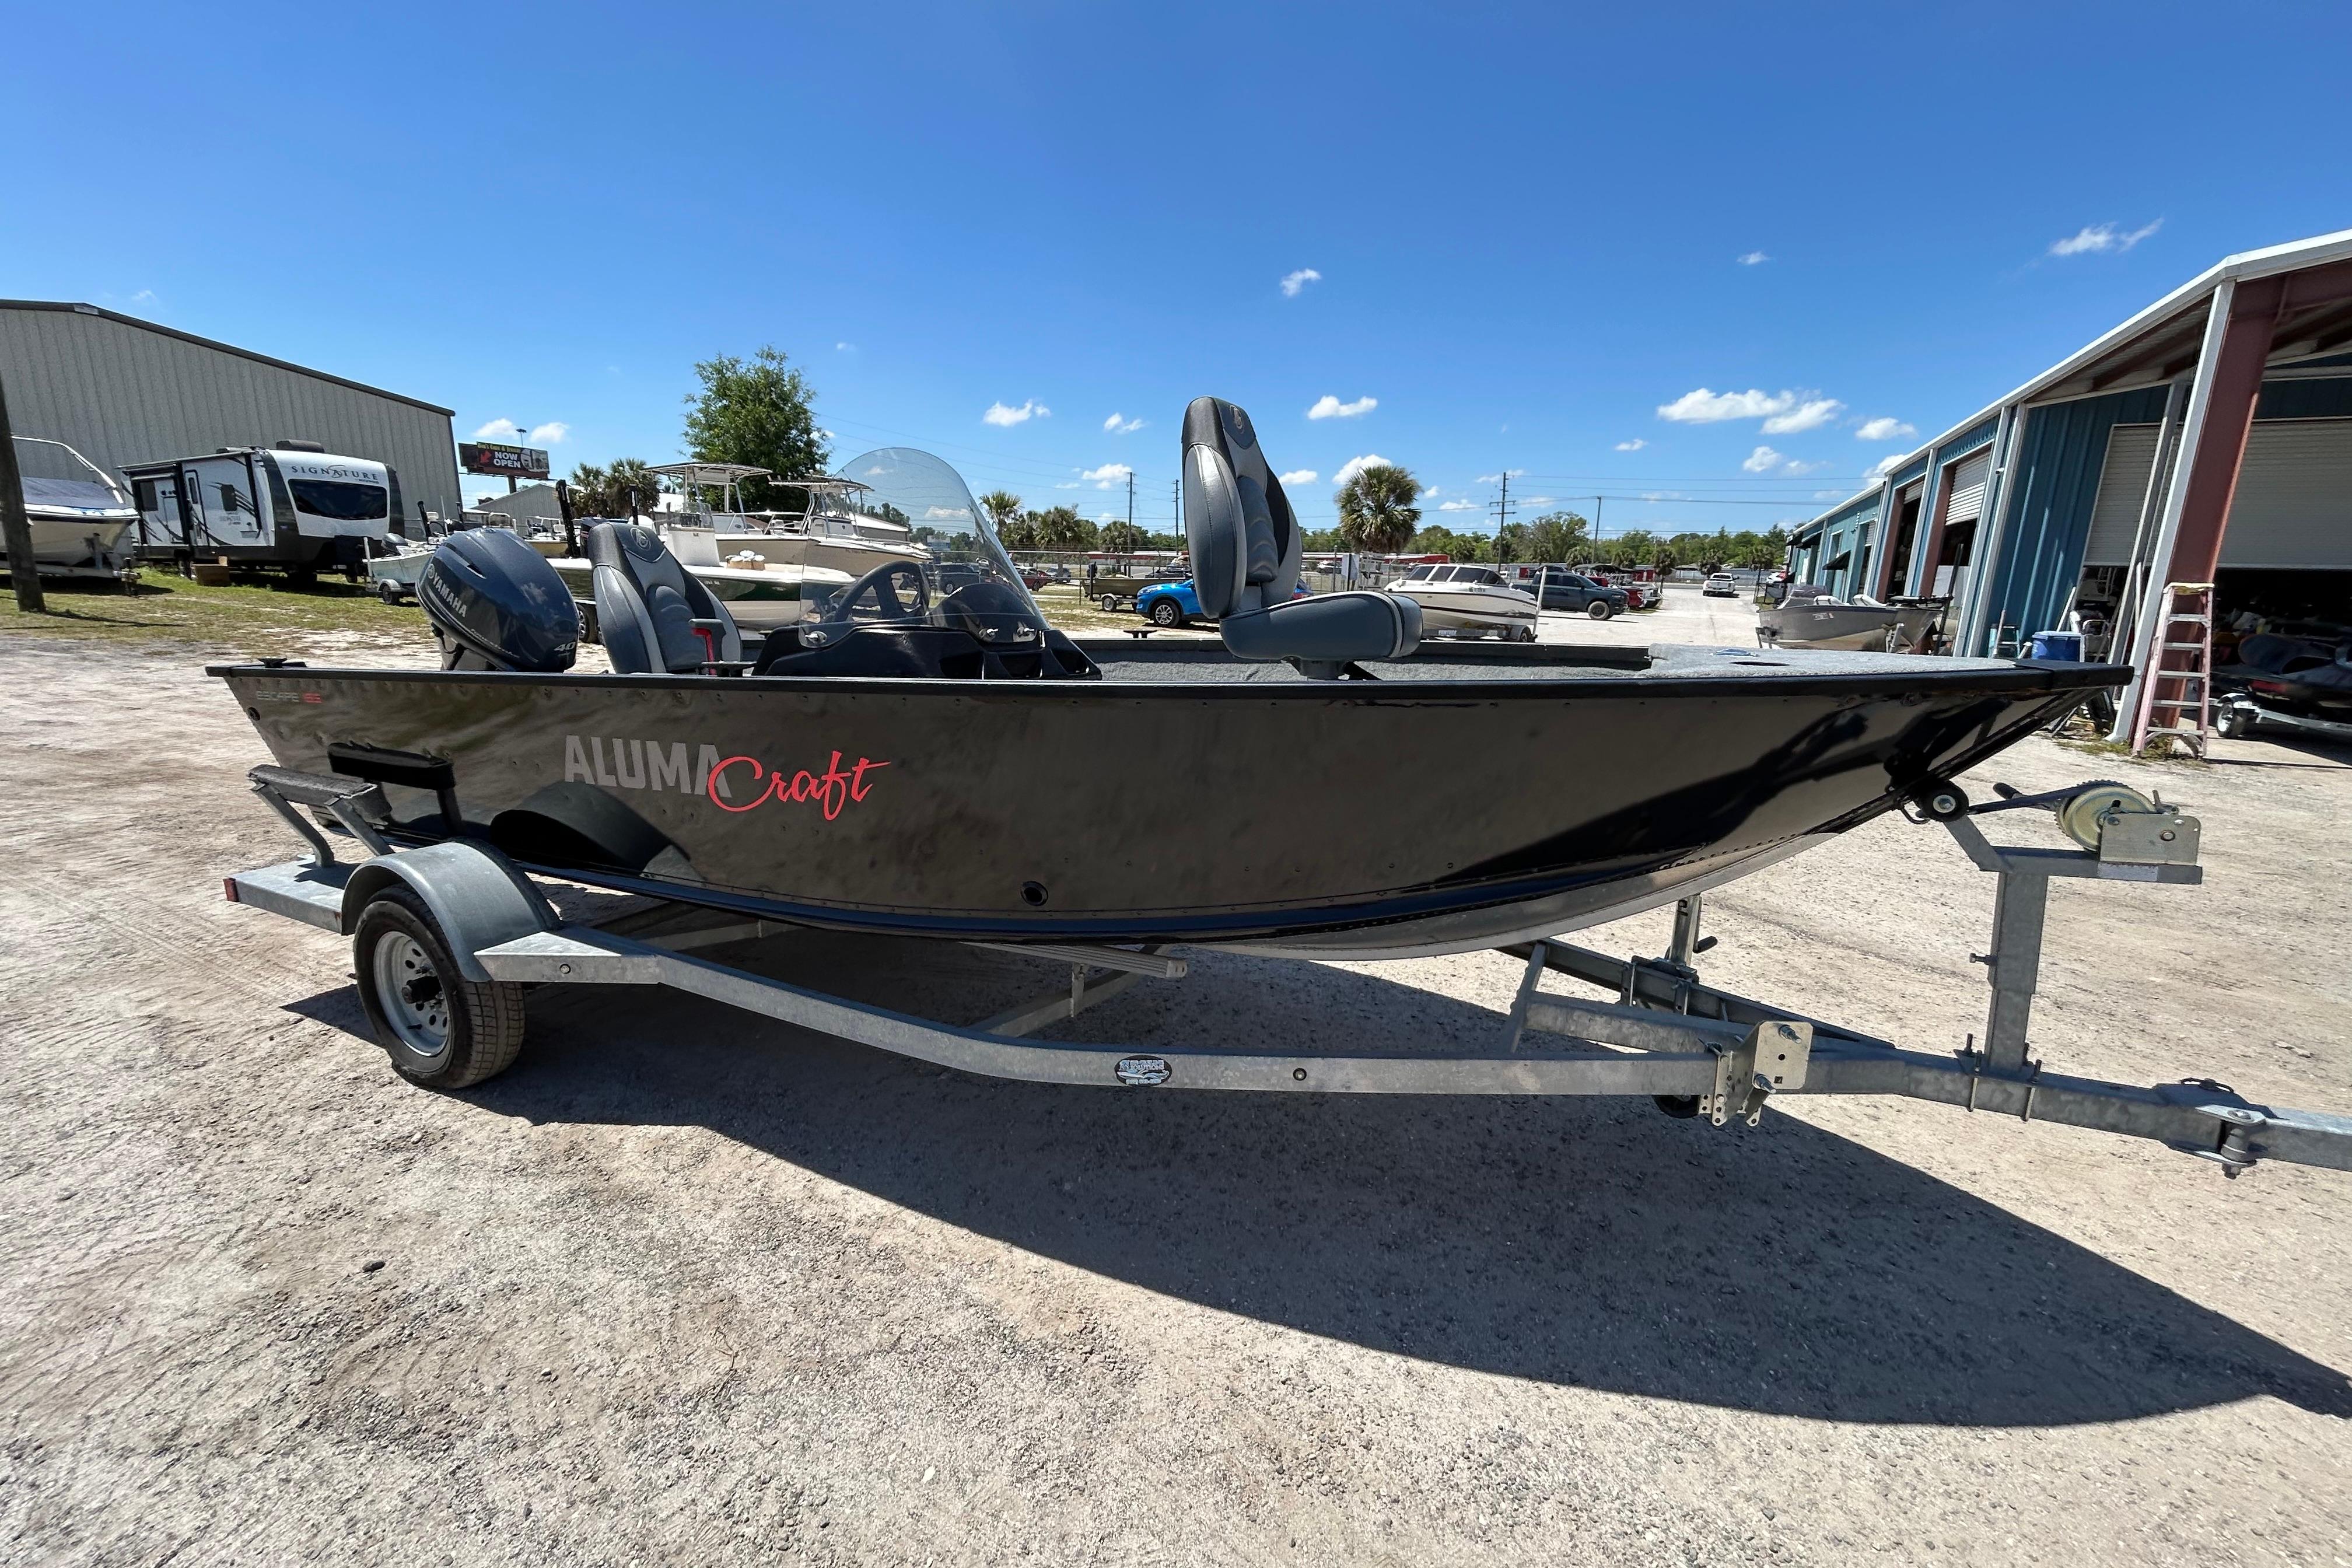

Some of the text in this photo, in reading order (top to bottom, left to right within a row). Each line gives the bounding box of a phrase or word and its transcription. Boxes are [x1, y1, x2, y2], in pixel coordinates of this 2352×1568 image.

[495, 452, 517, 461] NOW
[494, 459, 521, 468] OPEN
[291, 466, 379, 481] SIGNATURE
[433, 572, 467, 618] YAMAHA
[554, 642, 576, 652] 40
[564, 734, 891, 821] ALUMA Craft
